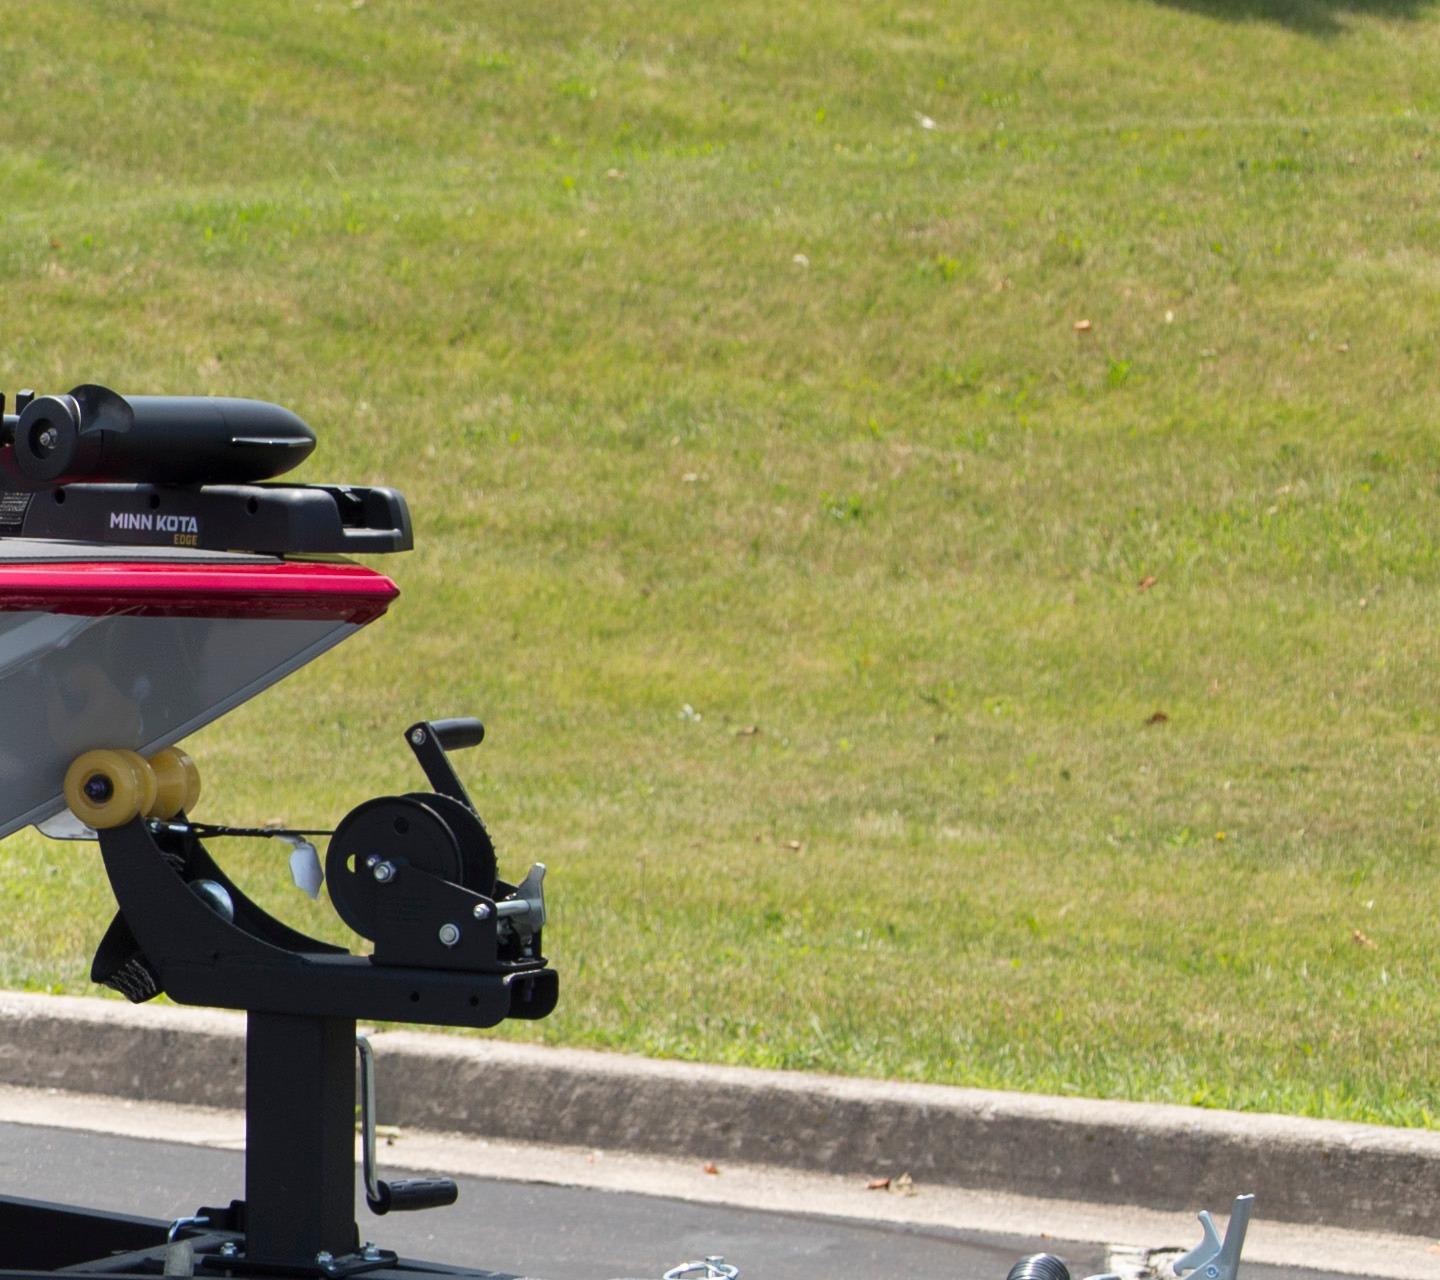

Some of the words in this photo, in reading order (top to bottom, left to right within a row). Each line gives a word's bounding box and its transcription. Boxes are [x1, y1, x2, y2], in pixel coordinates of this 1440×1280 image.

[110, 512, 152, 531] MINN
[156, 514, 198, 533] KOTA
[173, 534, 198, 546] EDGE
